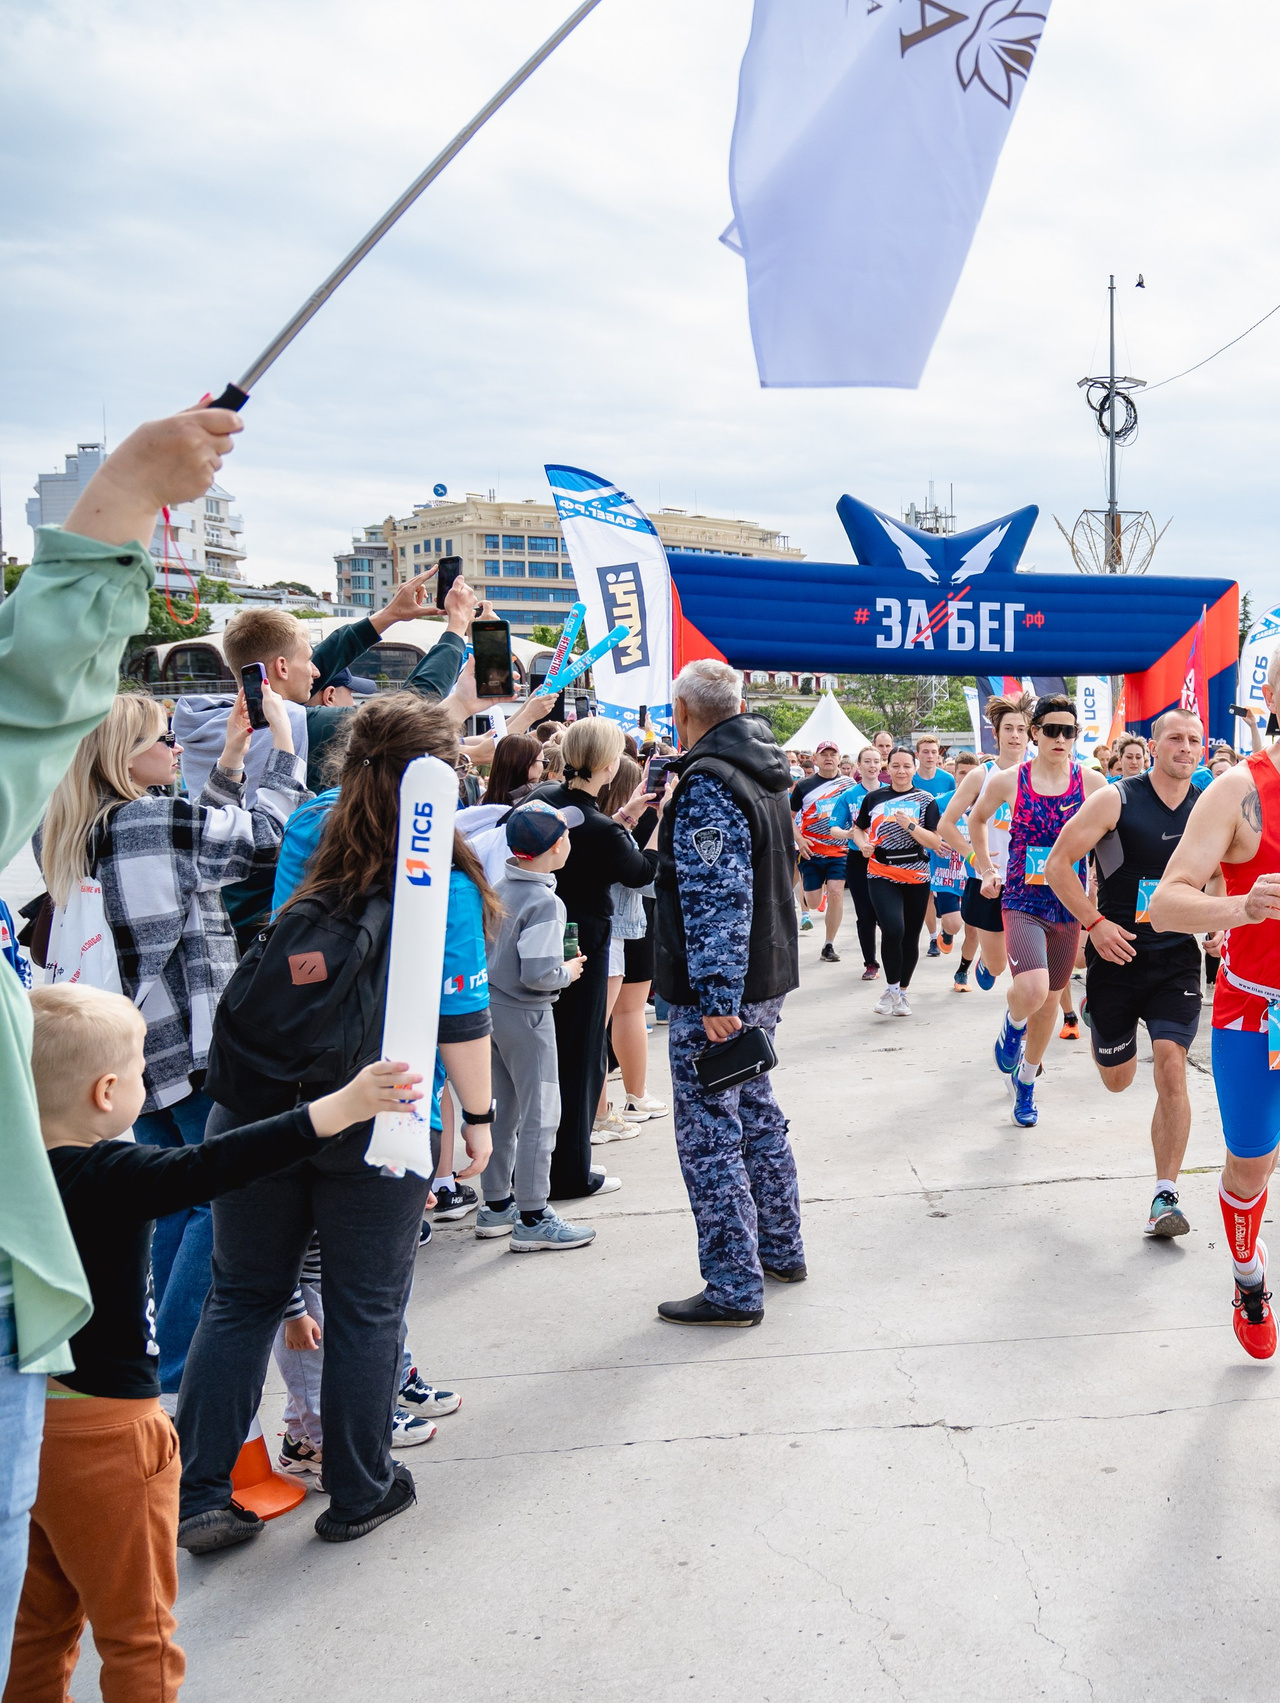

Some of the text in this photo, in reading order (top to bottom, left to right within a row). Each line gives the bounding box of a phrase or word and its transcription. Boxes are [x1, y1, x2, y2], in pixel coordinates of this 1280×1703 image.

[548, 636, 571, 677] #ЕДИНСТВО
[1249, 655, 1269, 701] ПСБ
[411, 802, 434, 853] ПСБ
[469, 968, 488, 990] ПСБ
[1098, 1044, 1126, 1055] NIKE PRO
